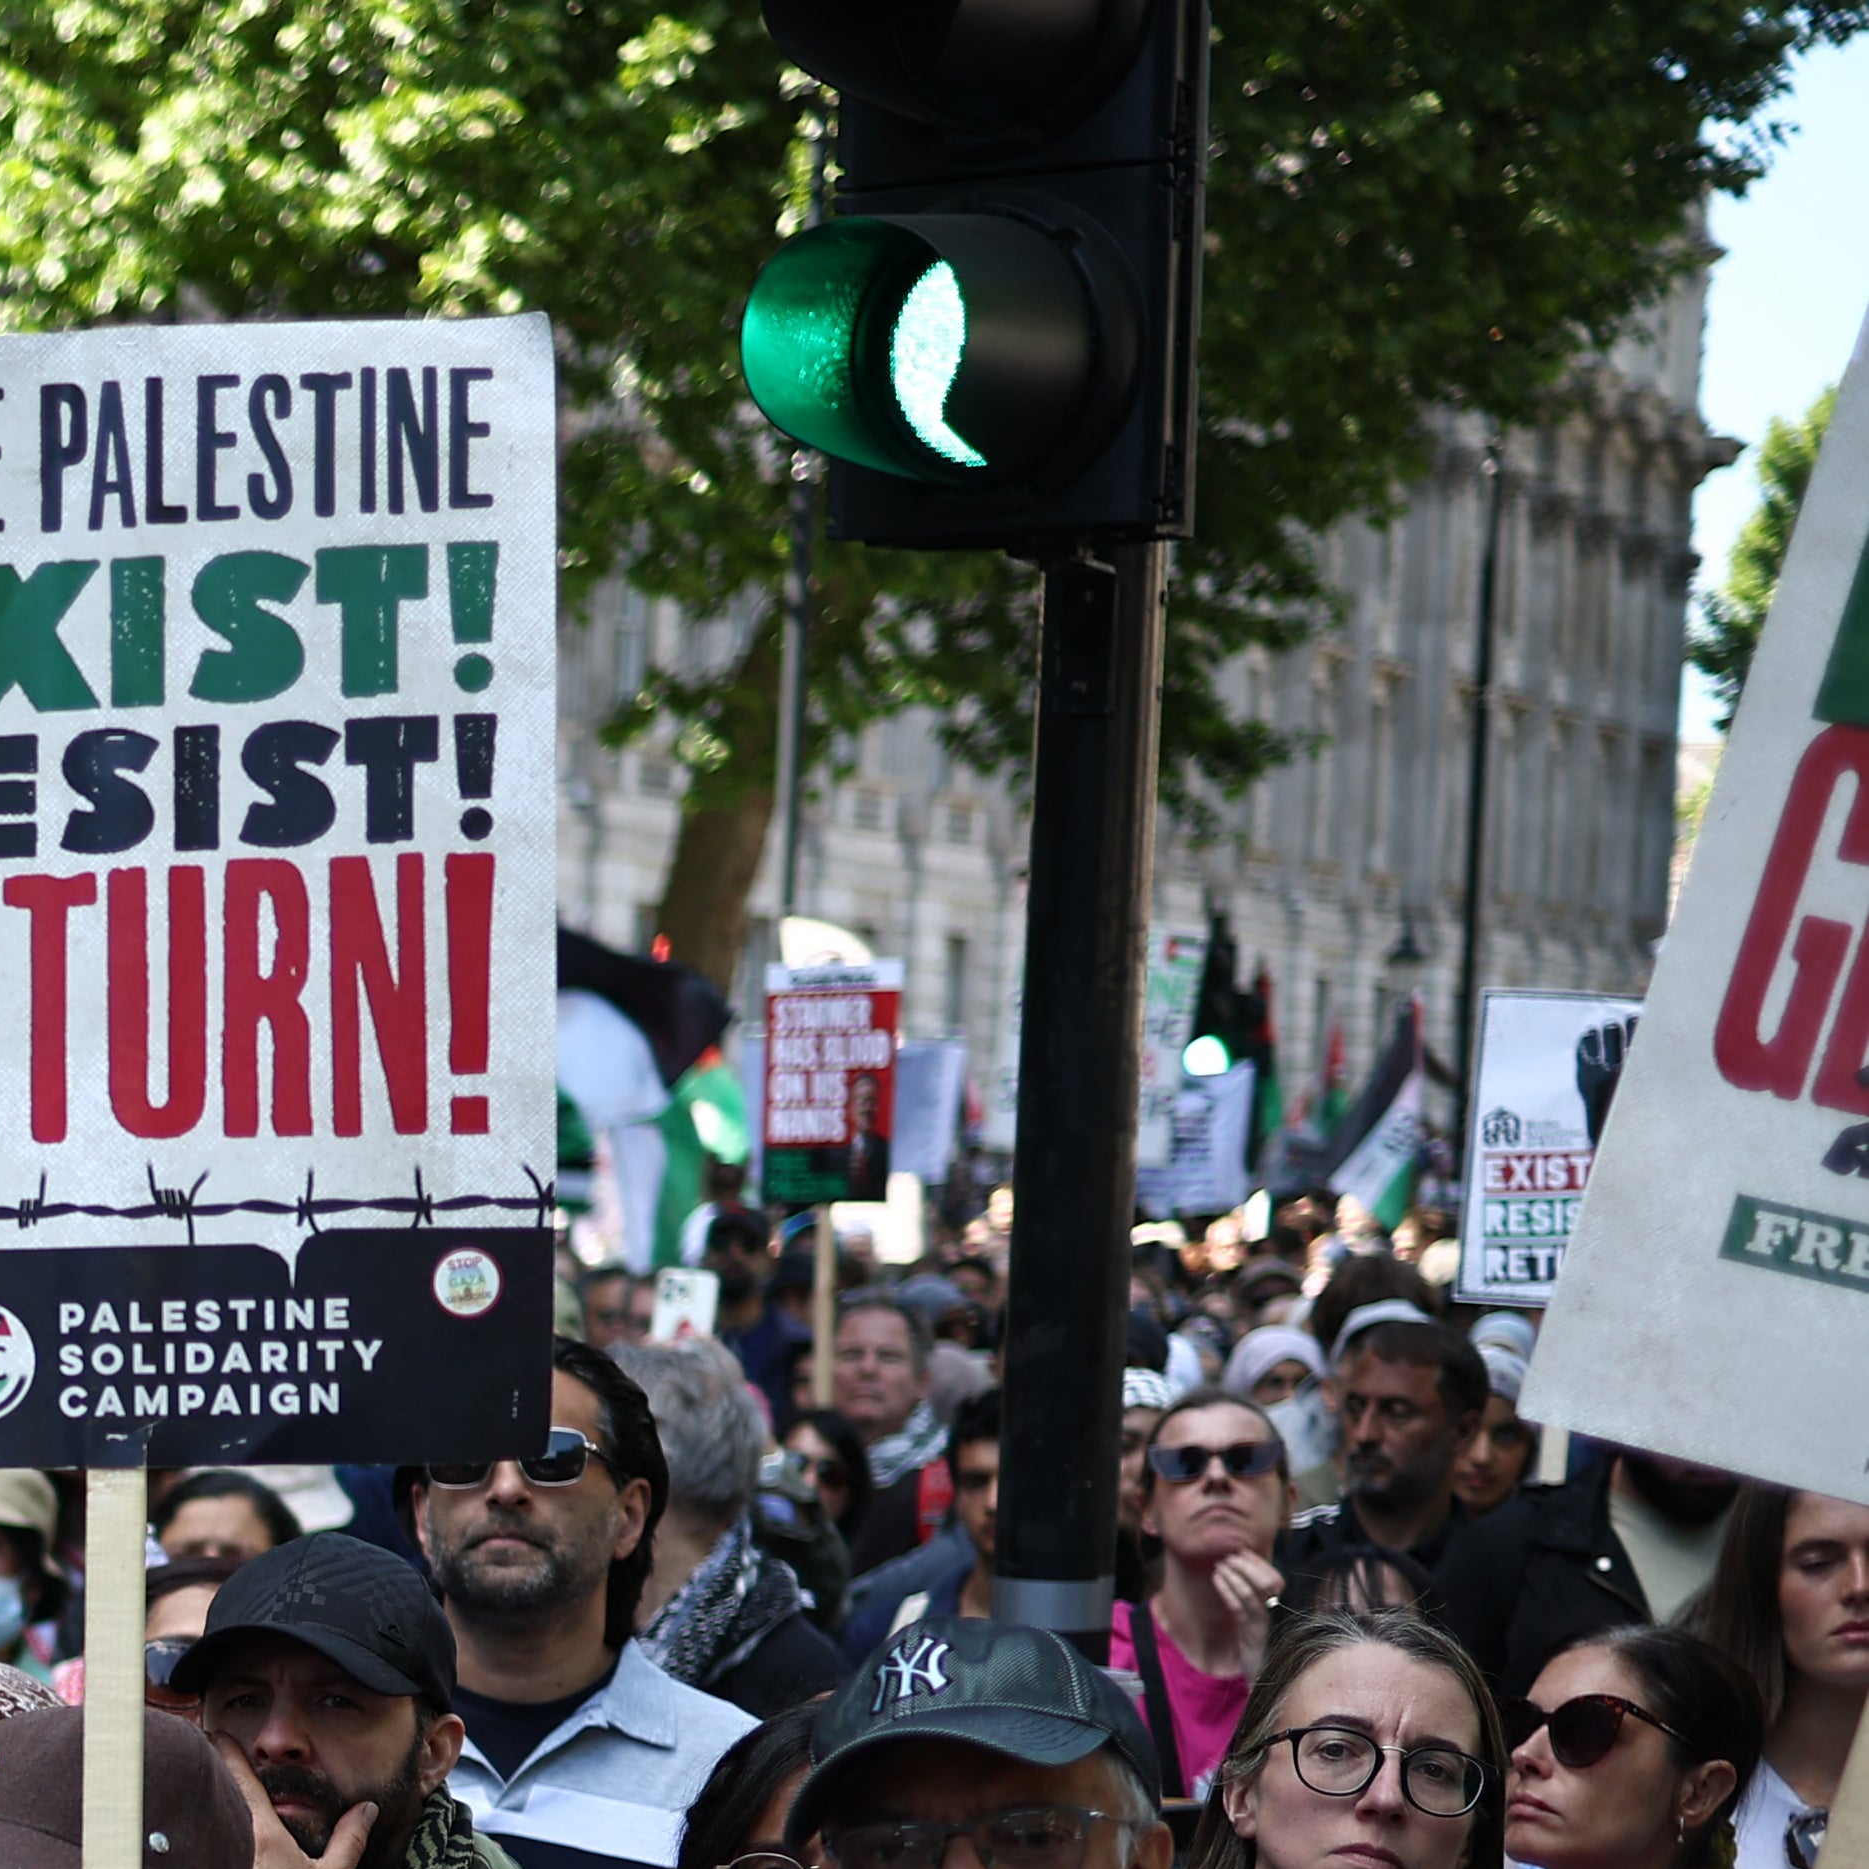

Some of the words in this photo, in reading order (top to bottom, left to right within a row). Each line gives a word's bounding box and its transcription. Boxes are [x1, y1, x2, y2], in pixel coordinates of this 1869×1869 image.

[39, 366, 495, 532] PALESTINE
[447, 1256, 483, 1270] STOP
[449, 1275, 486, 1287] GAZA
[58, 1298, 351, 1335] PALESTINE
[58, 1339, 384, 1377] SOLIDARITY
[58, 1383, 342, 1419] CAMPAIGN
[870, 1635, 952, 1715] NY
